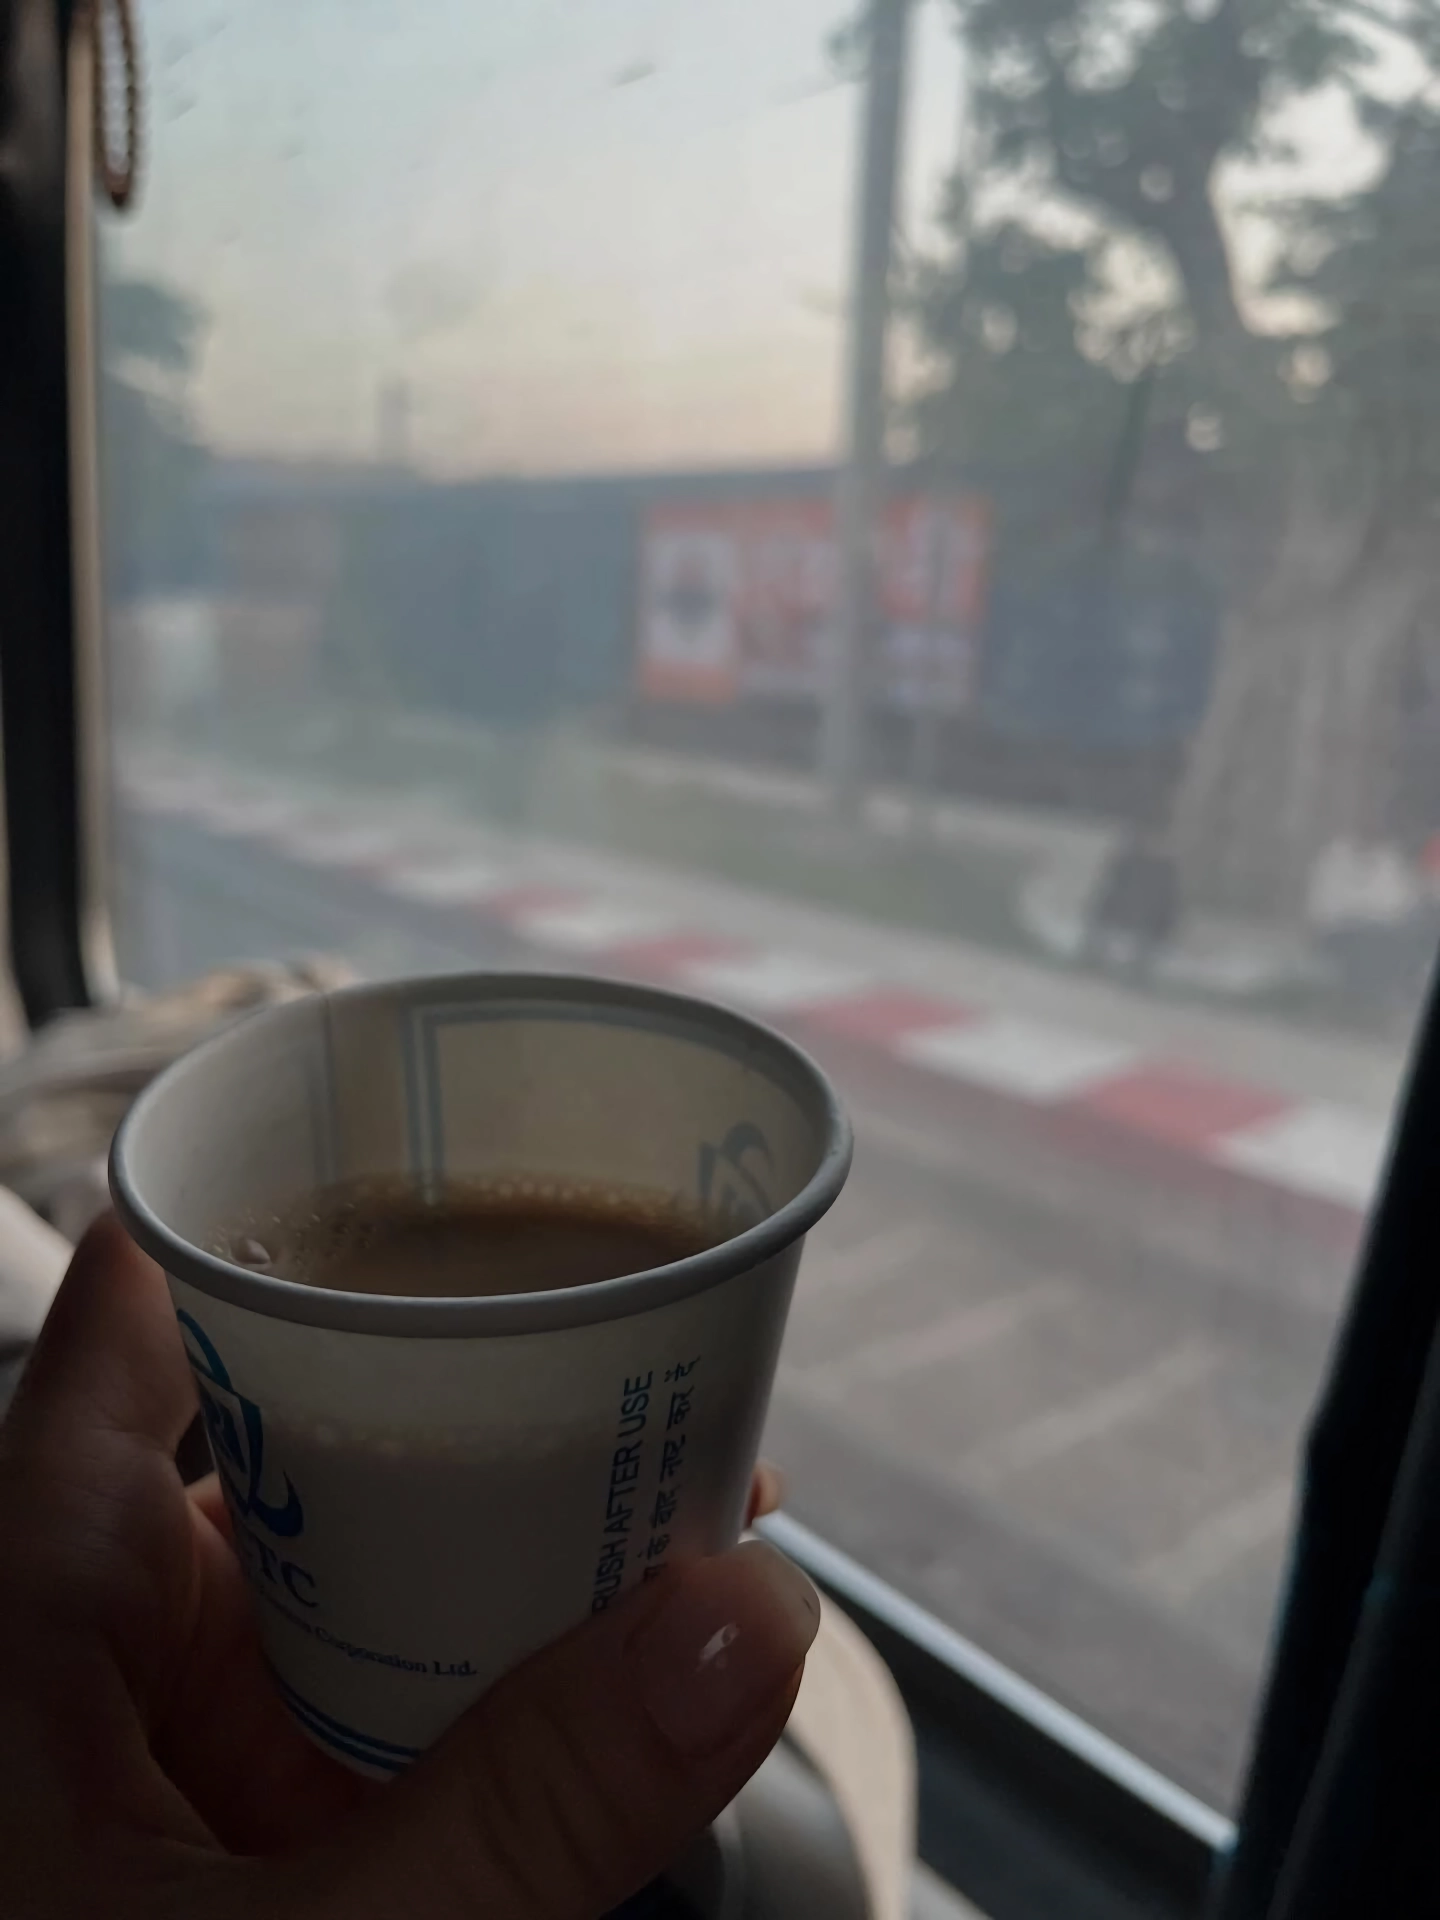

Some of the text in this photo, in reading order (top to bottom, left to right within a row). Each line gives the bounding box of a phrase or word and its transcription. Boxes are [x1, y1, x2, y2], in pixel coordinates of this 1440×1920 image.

[617, 1371, 653, 1438] USE
[666, 1384, 695, 1431] कर
[603, 1440, 643, 1534] AFTER
